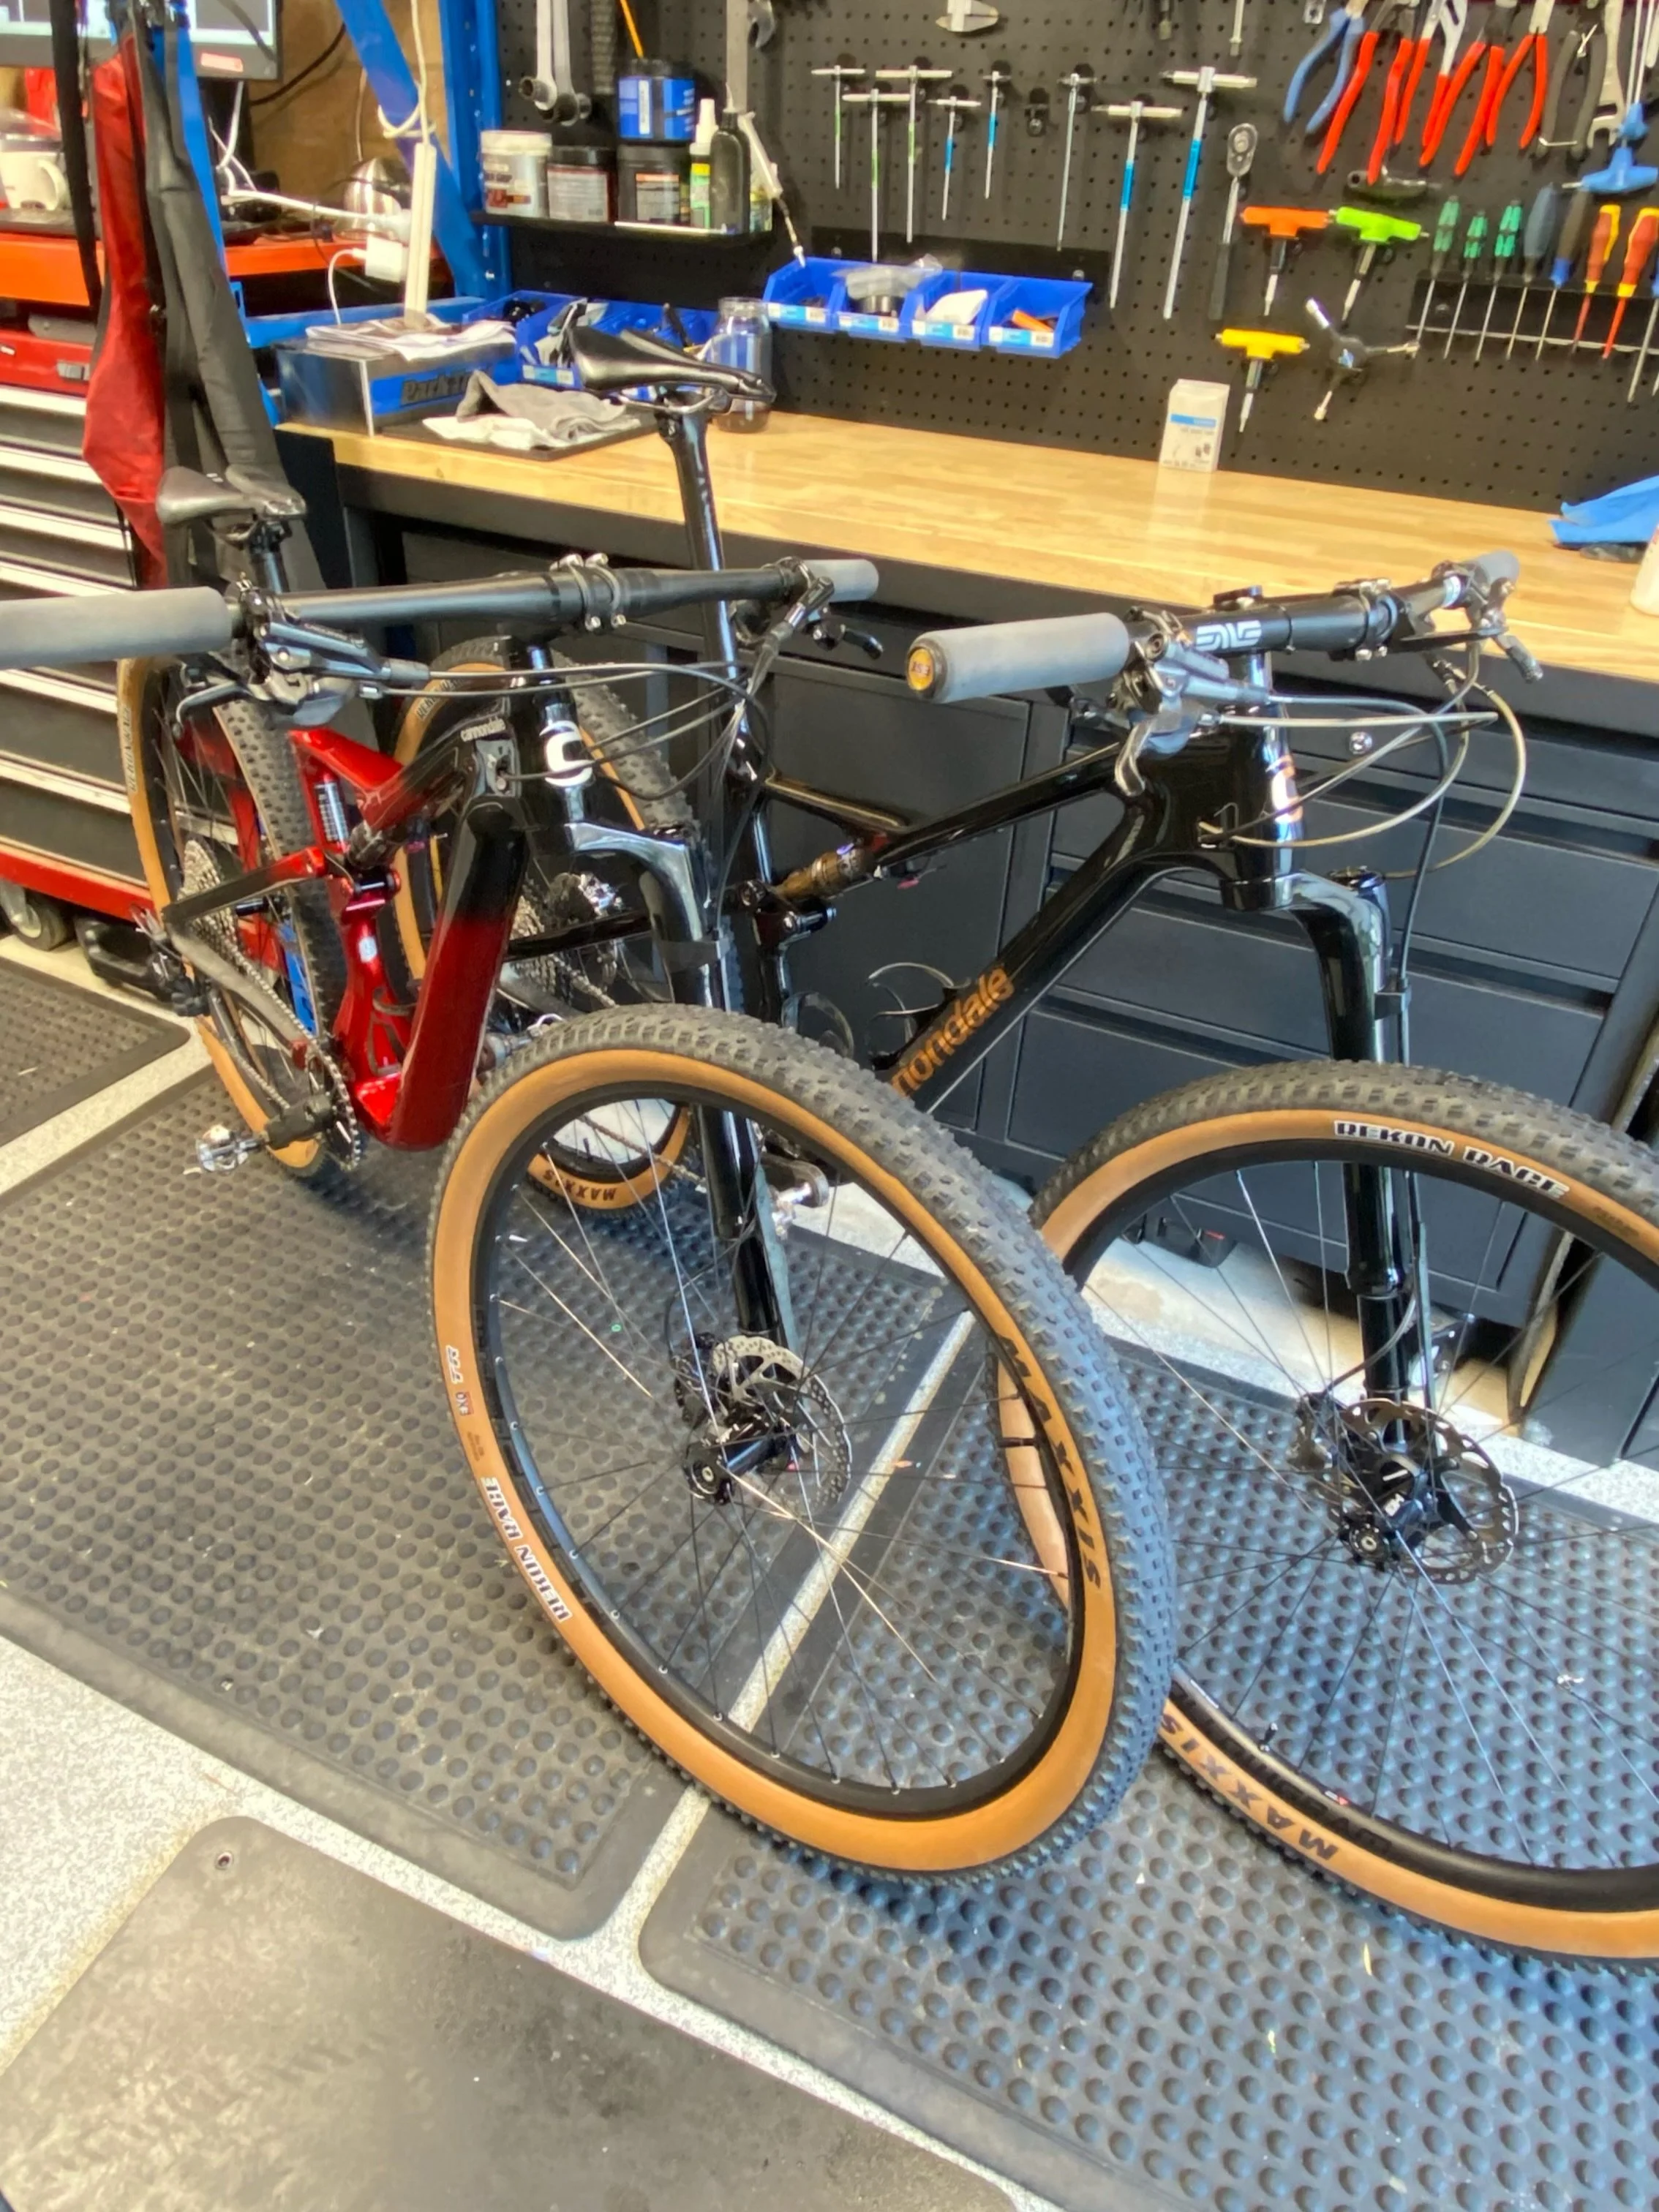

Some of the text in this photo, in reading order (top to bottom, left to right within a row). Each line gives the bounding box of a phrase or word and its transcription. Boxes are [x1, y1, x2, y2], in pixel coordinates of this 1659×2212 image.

[890, 965, 1015, 1097] nondale
[1333, 1119, 1571, 1200] REKON RACE
[479, 1475, 523, 1541] RACE
[514, 1543, 574, 1622] REKON
[1160, 1713, 1339, 1861] MAXXIS
